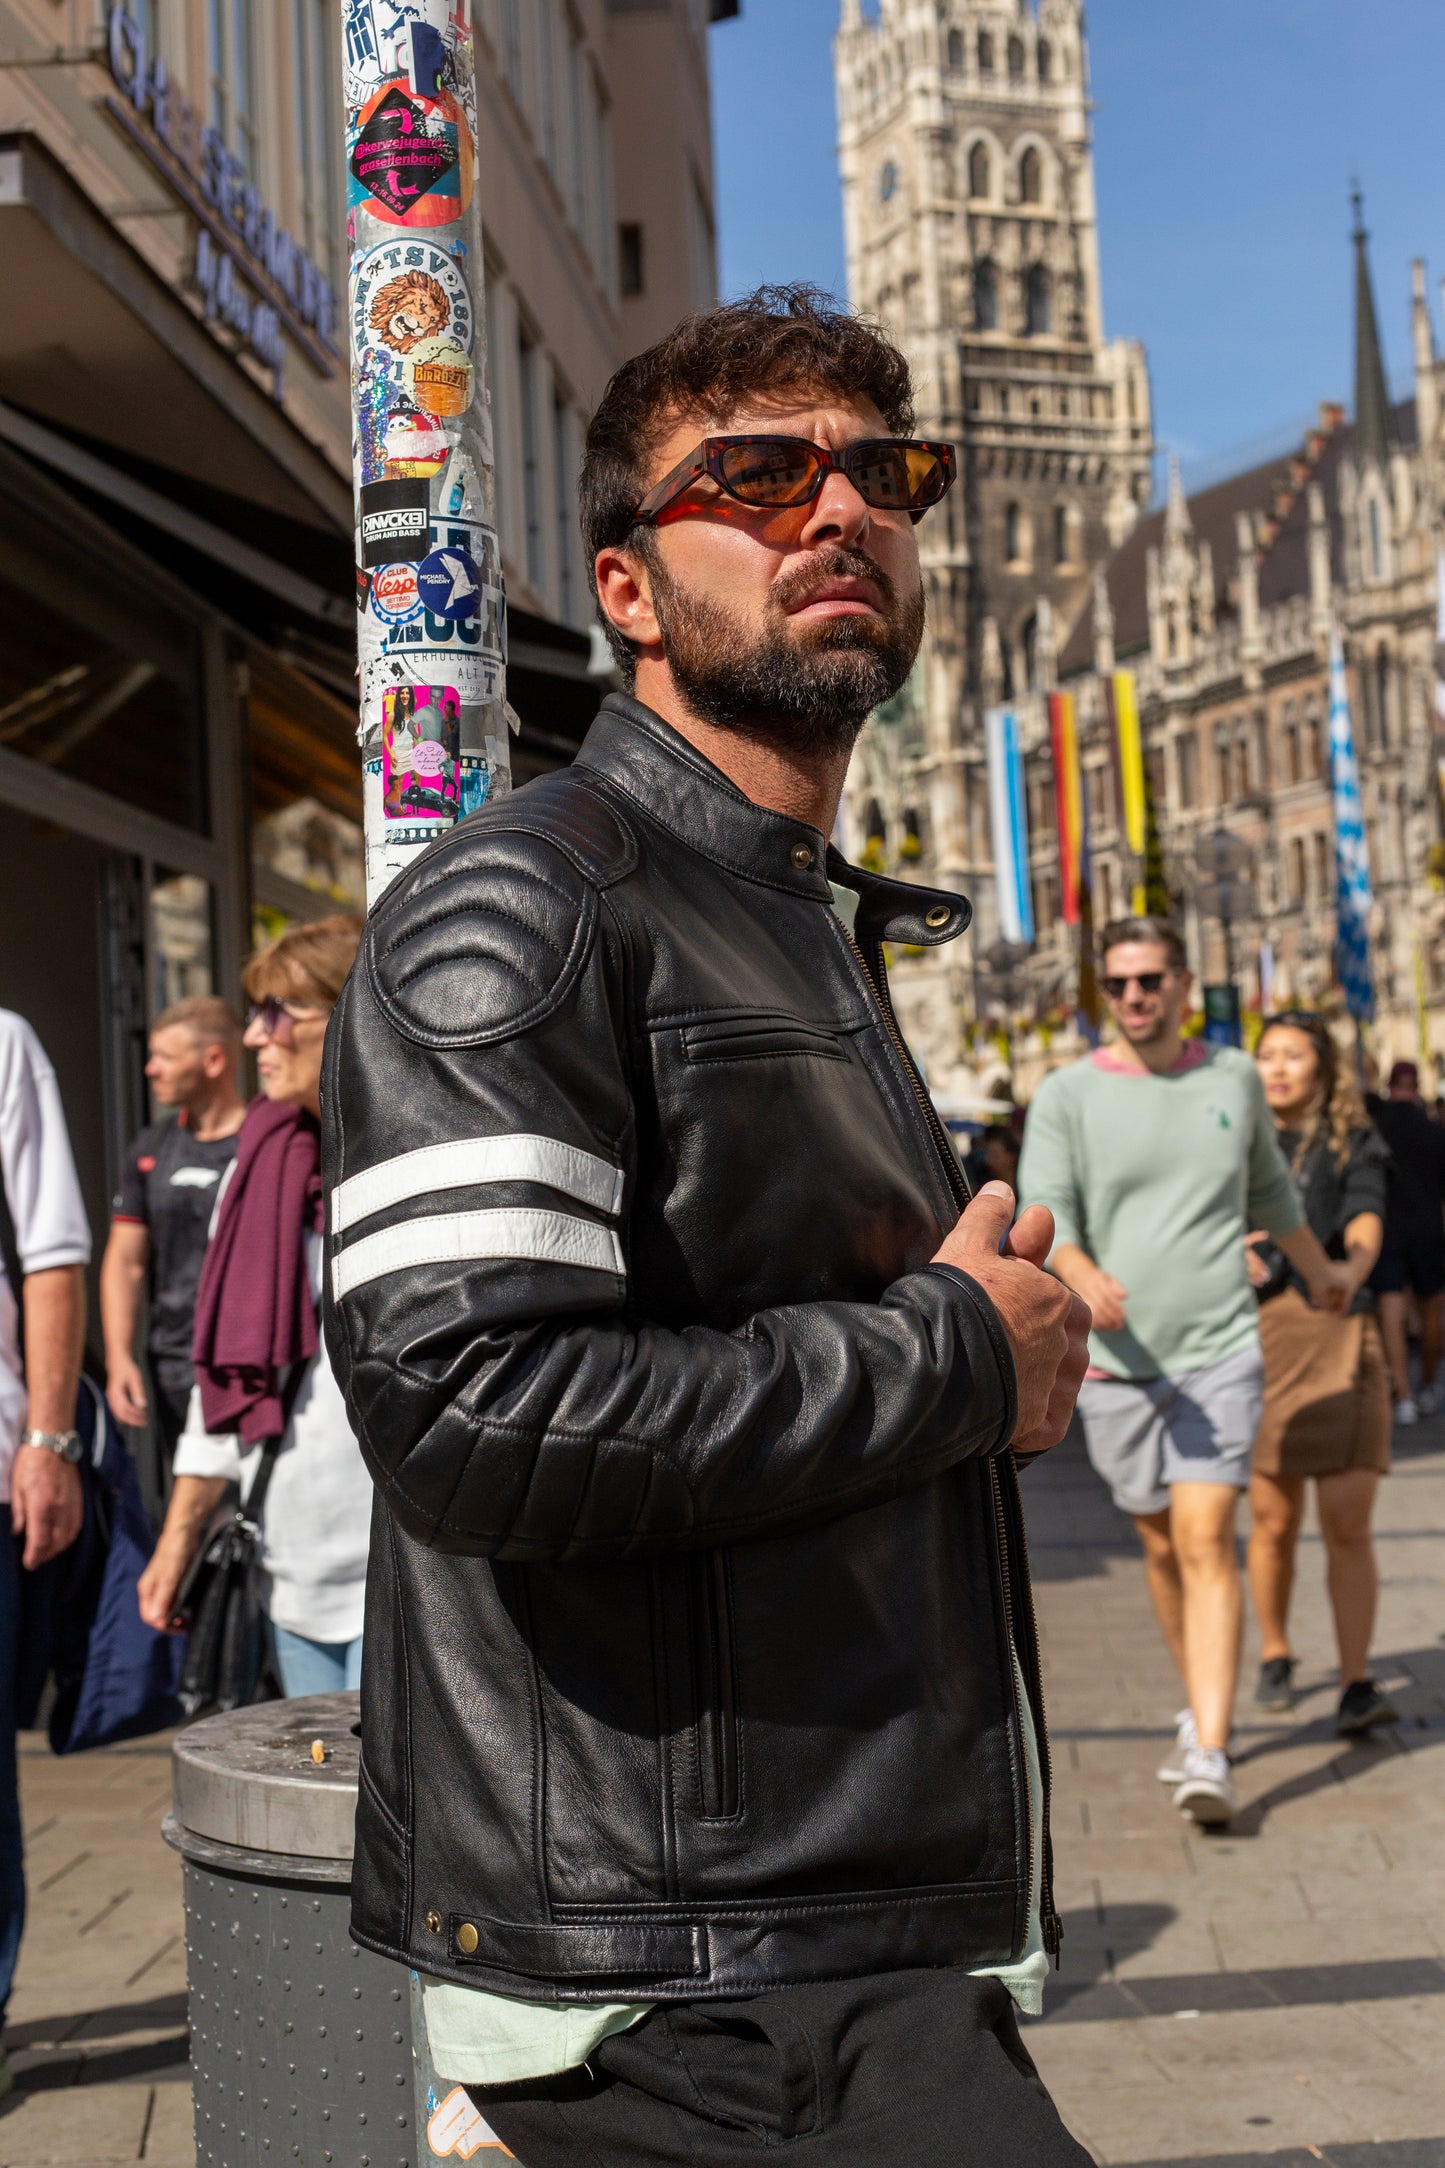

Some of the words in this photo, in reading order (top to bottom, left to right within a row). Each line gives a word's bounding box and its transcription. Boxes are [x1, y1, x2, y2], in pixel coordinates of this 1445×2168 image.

[359, 152, 442, 177] grasellenbach
[383, 246, 449, 274] TSV
[366, 533, 382, 543] DRUM
[382, 531, 398, 539] AND
[398, 529, 421, 537] BASS
[387, 567, 408, 577] CLUB
[373, 571, 418, 599] Vesp
[458, 668, 478, 680] ALT
